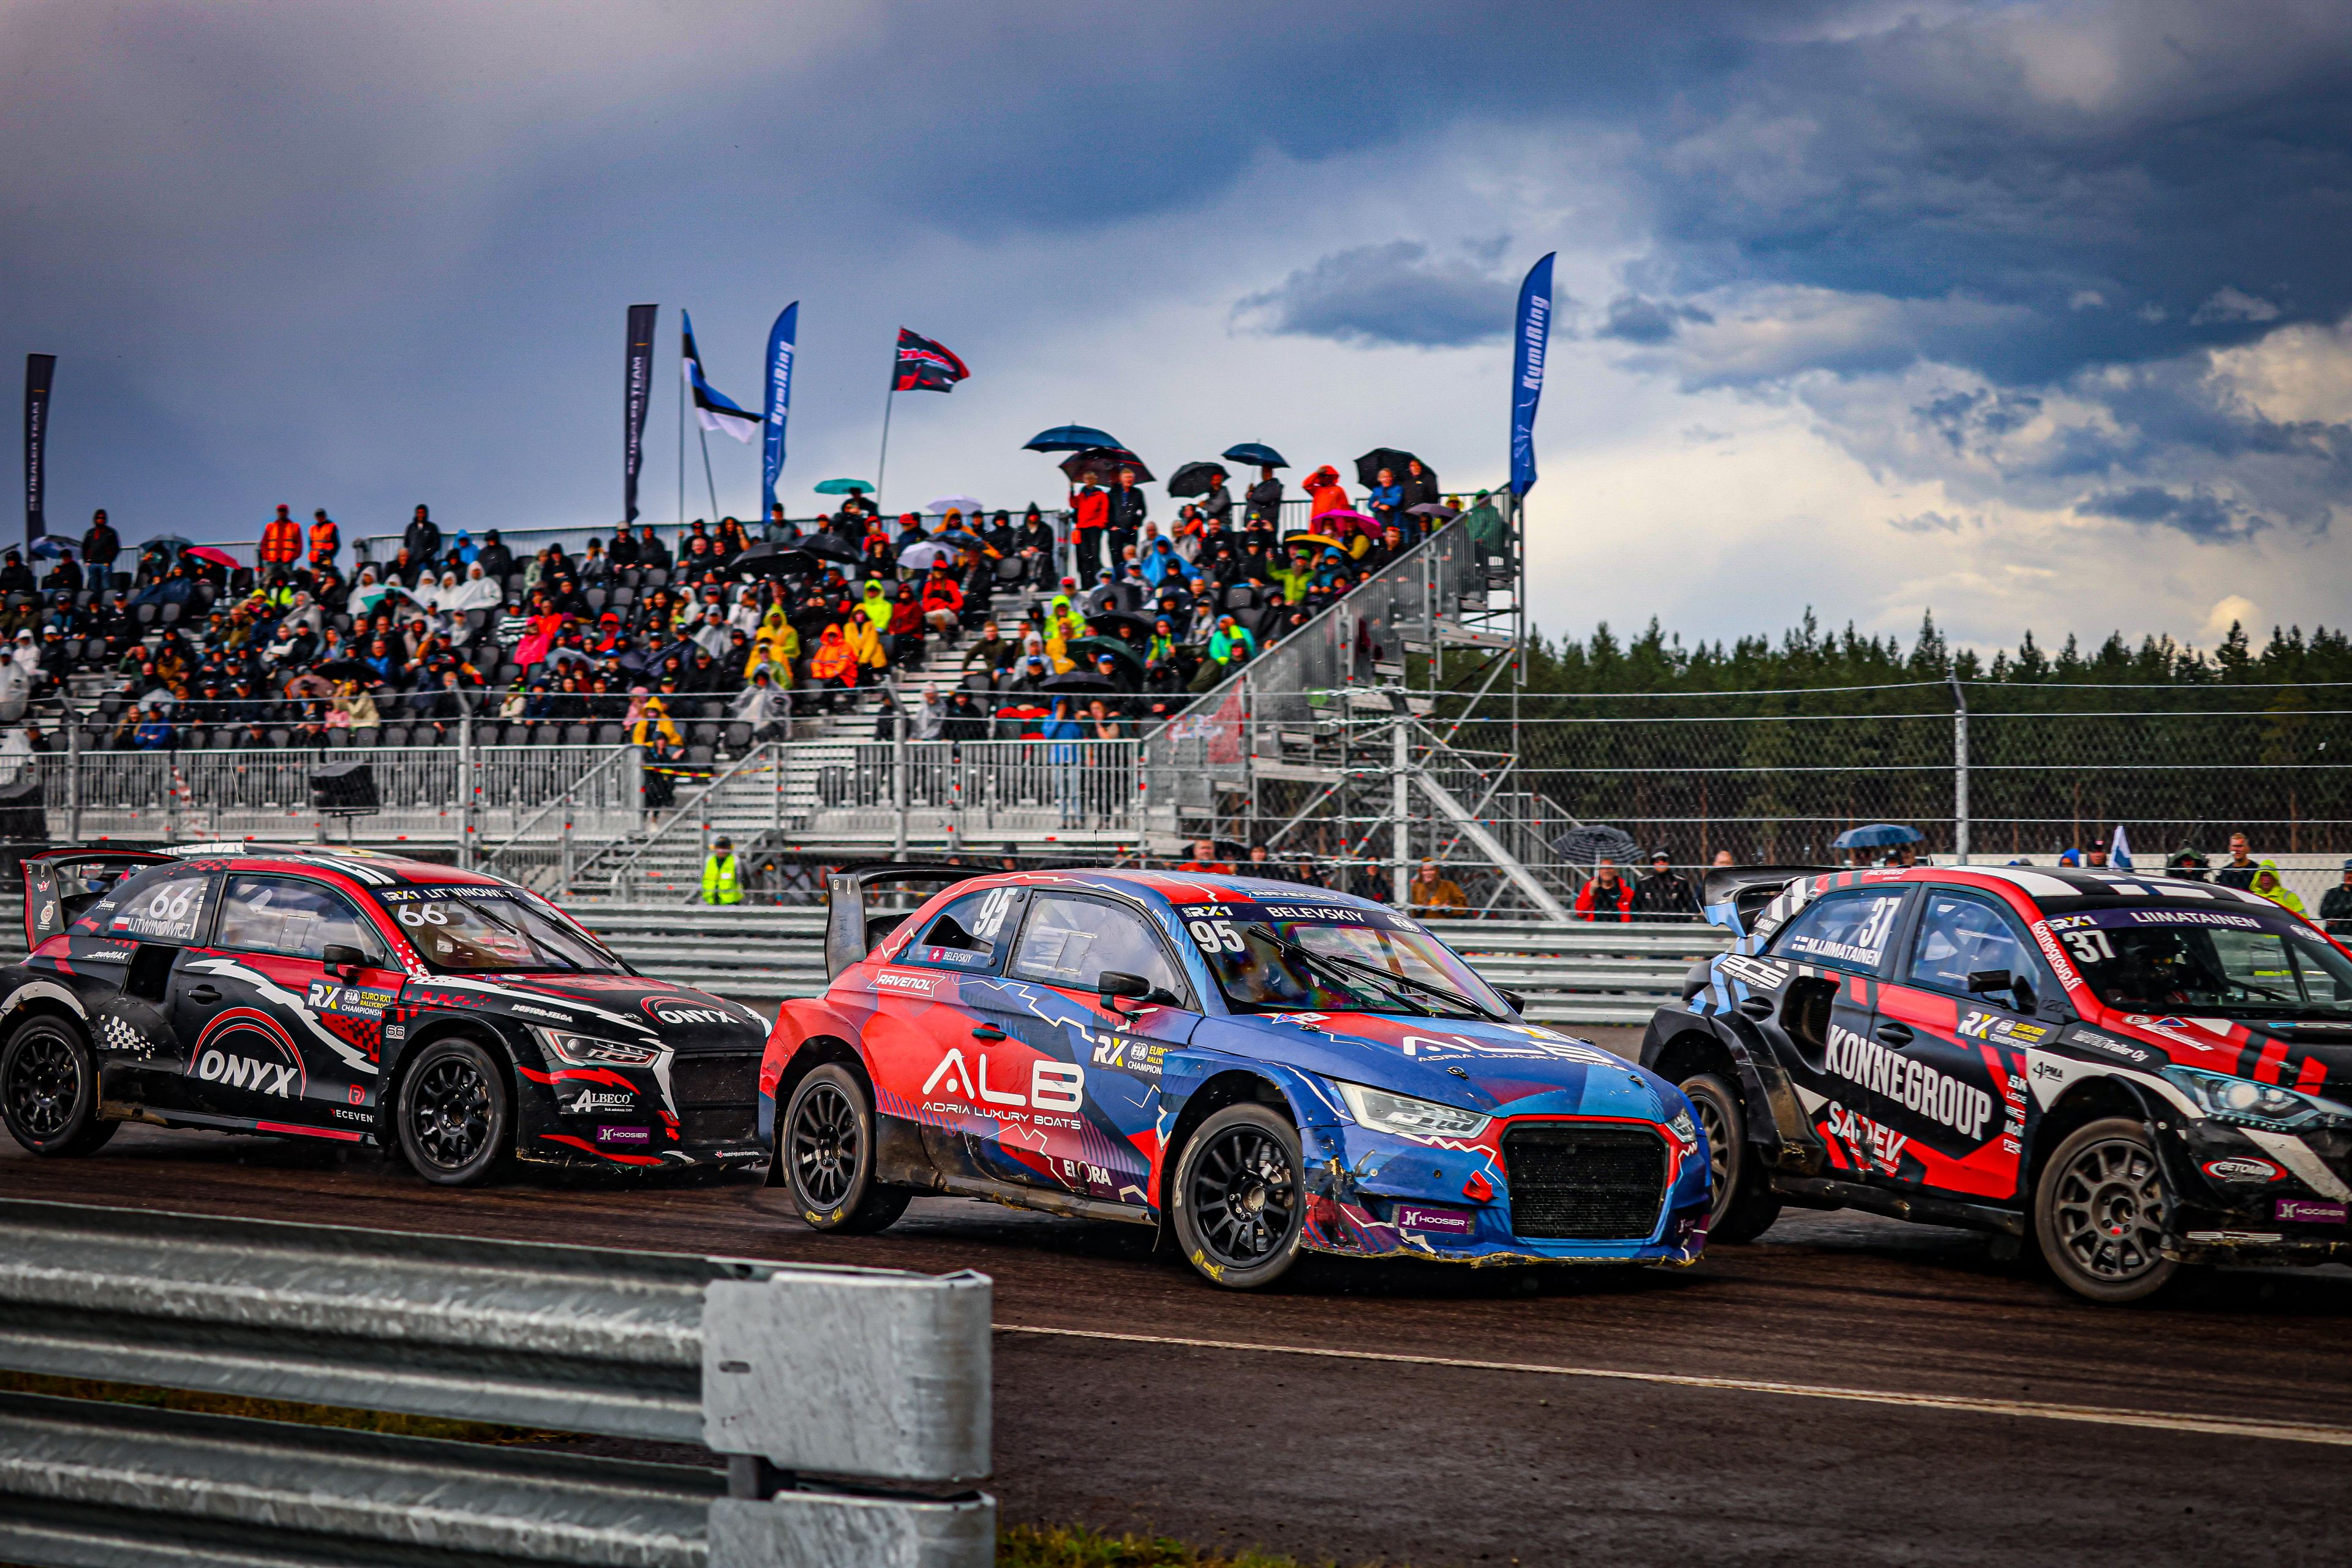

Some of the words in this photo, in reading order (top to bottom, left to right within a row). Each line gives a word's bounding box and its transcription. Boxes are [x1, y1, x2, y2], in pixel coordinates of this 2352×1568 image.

[1523, 295, 1550, 390] KymiRing
[630, 356, 642, 397] TEAM
[770, 341, 795, 426] KymiRing
[31, 401, 40, 439] TEAM
[149, 885, 194, 920] 66
[387, 890, 421, 901] RX1
[423, 888, 519, 900] LITINOWIZ
[398, 903, 448, 927] 66
[973, 888, 1019, 937] 95
[1188, 905, 1234, 918] RX1
[1265, 907, 1365, 922] BELEVSKIY
[1858, 897, 1902, 949] 37
[2129, 911, 2262, 929] LIIMATAINEN
[127, 918, 192, 938] LITWINOWICZ
[1189, 920, 1246, 954] 95
[943, 951, 973, 963] BELEVSKIY
[1806, 937, 1882, 968] M.LIIMATAINEN
[2062, 930, 2116, 963] 37
[876, 974, 931, 990] RAVENOL
[307, 983, 342, 1010] RX
[361, 991, 379, 1002] EURO
[379, 993, 391, 1003] RX1
[658, 1009, 740, 1024] ONYX
[1958, 1011, 2001, 1039] RX
[386, 1025, 405, 1038] 66
[1093, 1035, 1130, 1068] RX
[1418, 1053, 1476, 1063] ADRIA
[2104, 1038, 2134, 1055] Trailer
[2131, 1050, 2149, 1063] Oy
[199, 1050, 298, 1099] ONYX
[922, 1048, 1085, 1113] ALB
[1127, 1061, 1163, 1075] CHAMPION
[1825, 1024, 1993, 1141] KONNEGROUP
[571, 1088, 630, 1112] ALBECO
[922, 1101, 971, 1115] ADRIA
[974, 1107, 1030, 1123] LUXURY
[1033, 1115, 1081, 1130] BOATS
[1419, 1216, 1466, 1226] HOOSIER
[2296, 1208, 2345, 1216] HOOSIER
